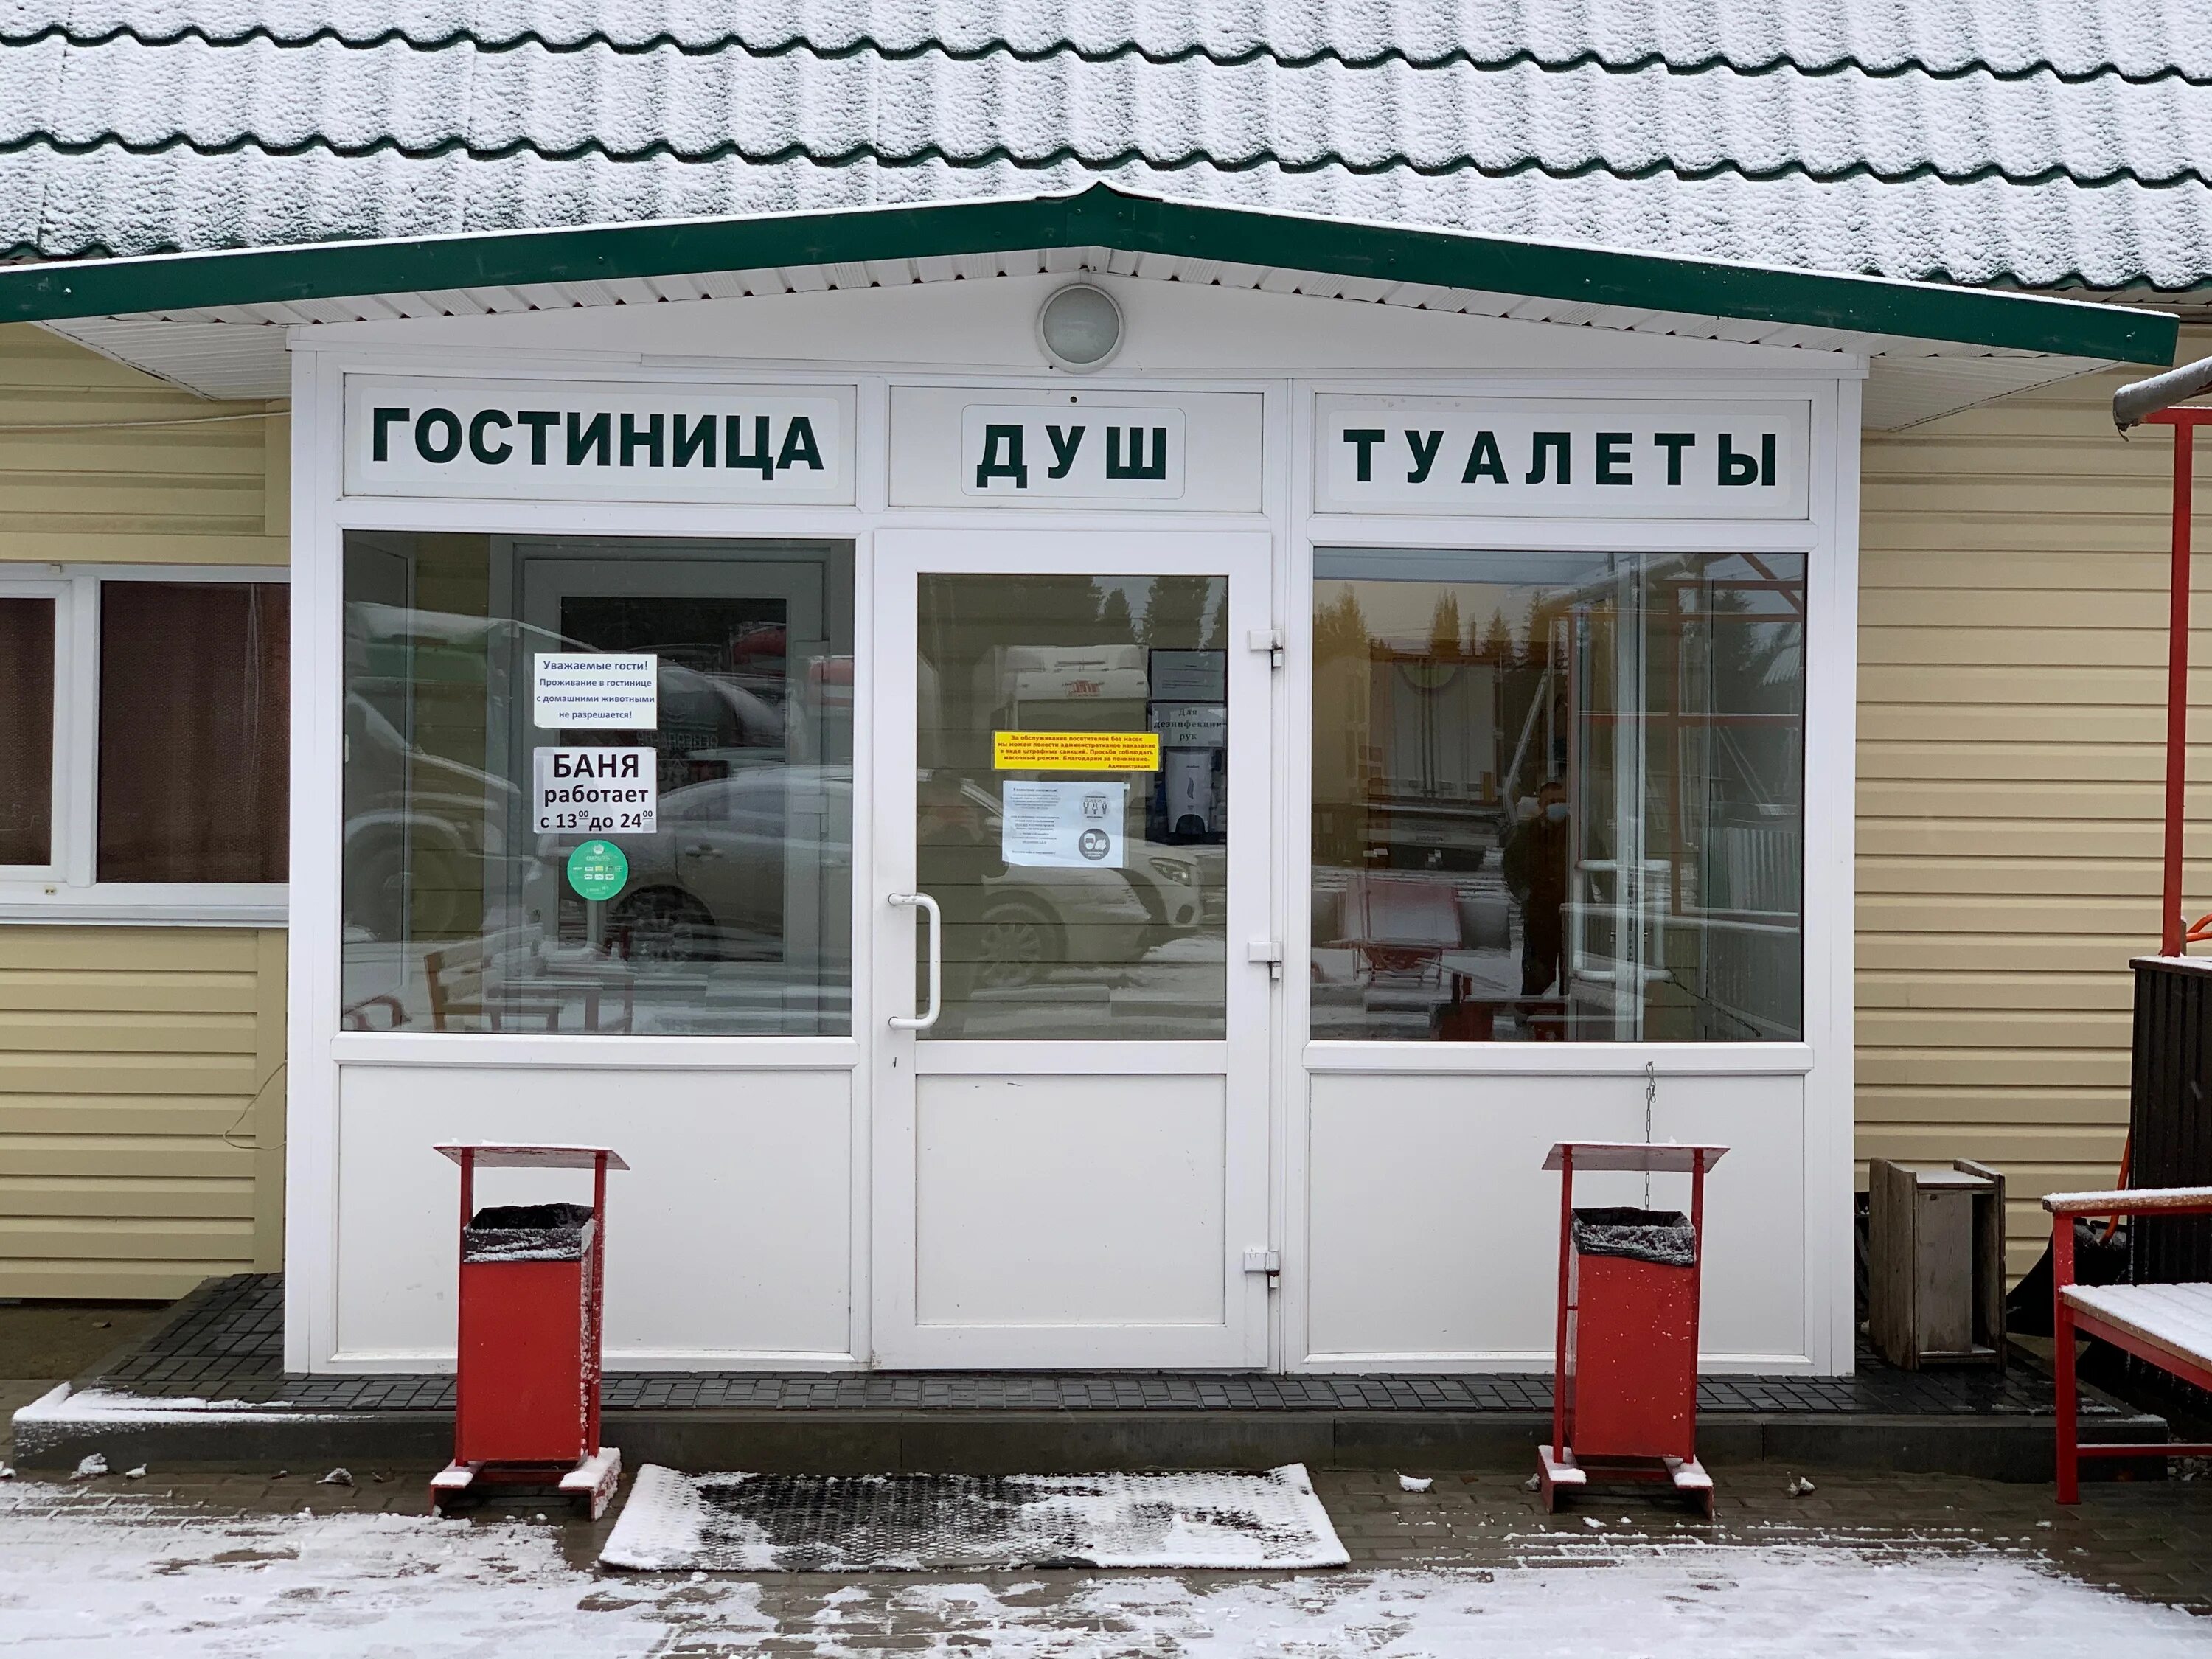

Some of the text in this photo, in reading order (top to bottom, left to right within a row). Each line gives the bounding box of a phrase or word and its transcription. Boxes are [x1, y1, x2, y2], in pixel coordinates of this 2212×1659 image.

[372, 407, 824, 481] ГОСТИНИЦА
[976, 424, 1167, 489] ДУШ
[1343, 428, 1776, 487] ТУАЛЕТЫ
[543, 660, 648, 671] Уважаемые гости!
[540, 678, 597, 688] Проживание
[571, 711, 632, 720] разрешается!
[1178, 708, 1197, 717] Для
[1179, 733, 1197, 742] рук
[554, 754, 639, 778] БАНЯ
[544, 784, 649, 807] работает
[540, 816, 549, 829] с
[588, 816, 613, 832] до
